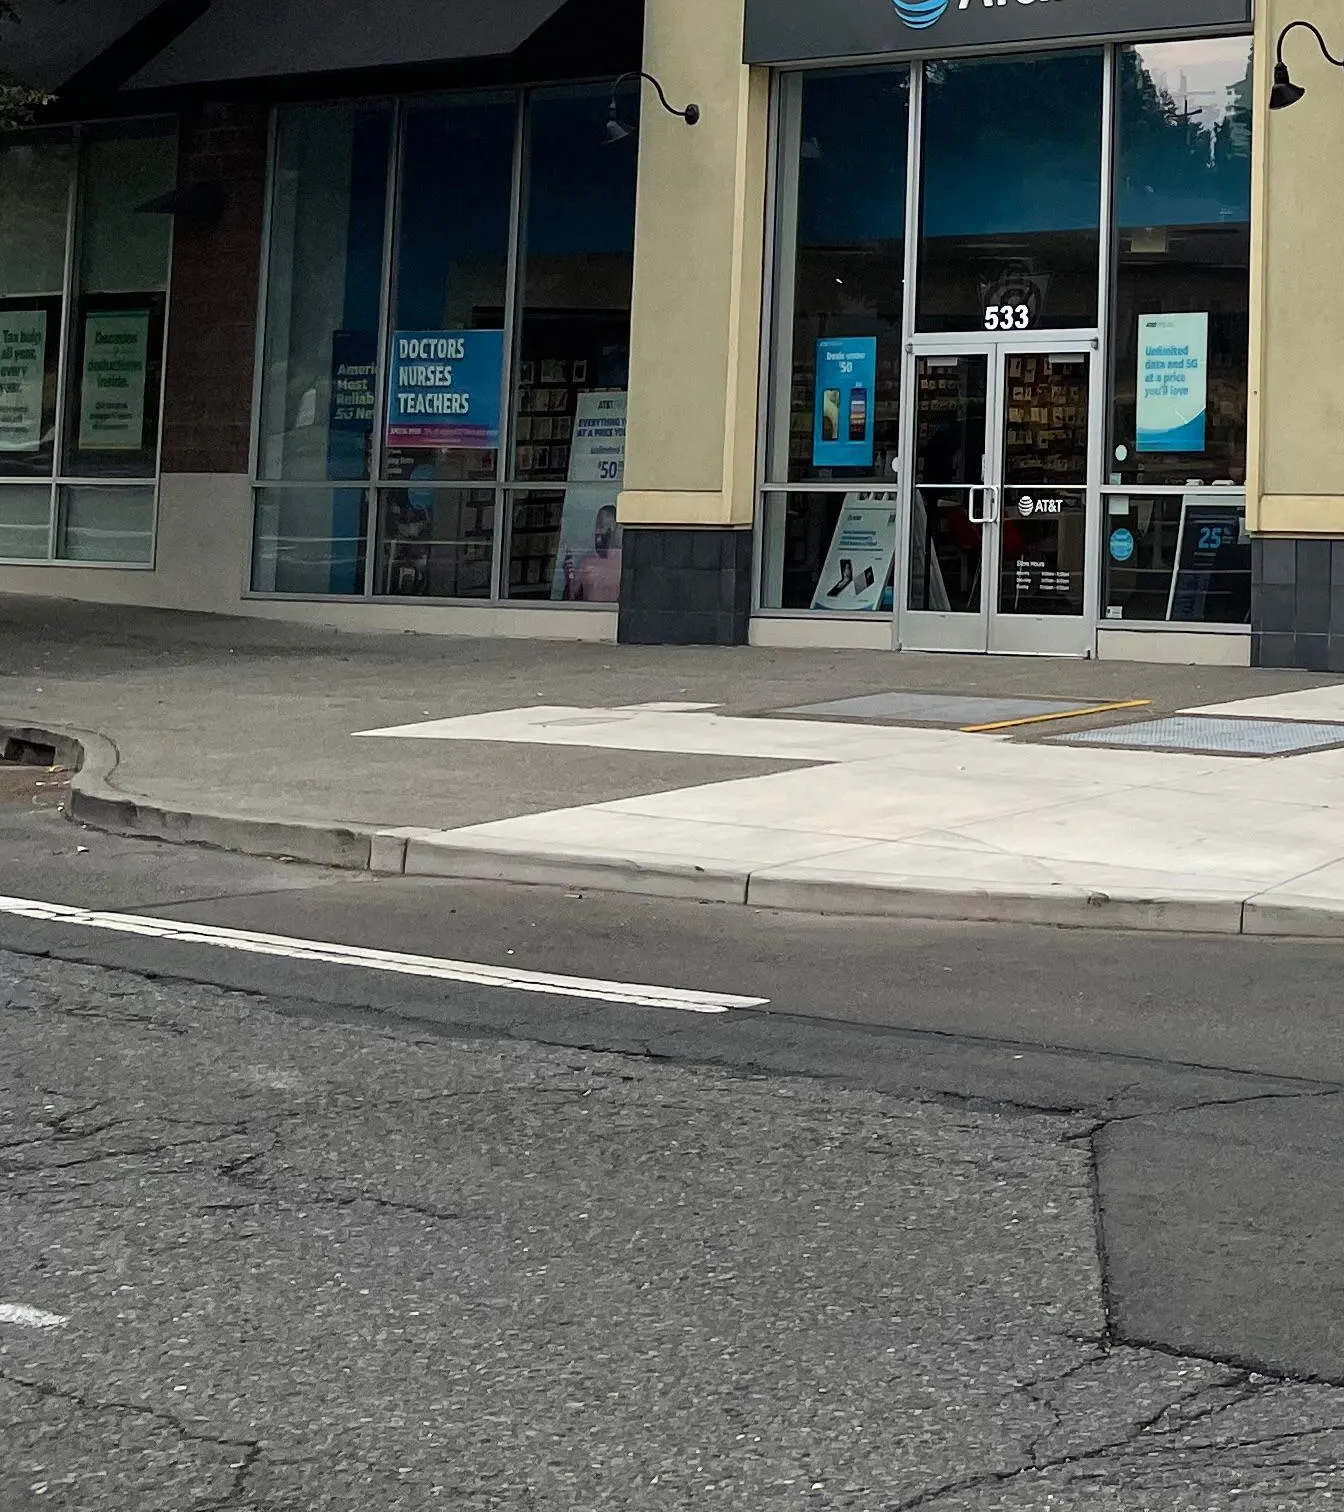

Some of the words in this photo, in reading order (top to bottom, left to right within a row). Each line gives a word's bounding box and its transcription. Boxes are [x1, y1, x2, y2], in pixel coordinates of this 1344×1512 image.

[984, 304, 1029, 330] 533
[398, 338, 465, 359] DOCTORS
[1145, 345, 1189, 357] Unlimited
[1145, 359, 1165, 370] data
[1167, 359, 1184, 369] and
[398, 365, 452, 386] NURSES
[1144, 373, 1154, 383] at
[1163, 373, 1186, 386] price
[1169, 386, 1189, 396] love
[397, 393, 470, 414] TEACHERS
[1034, 499, 1064, 513] AT&T
